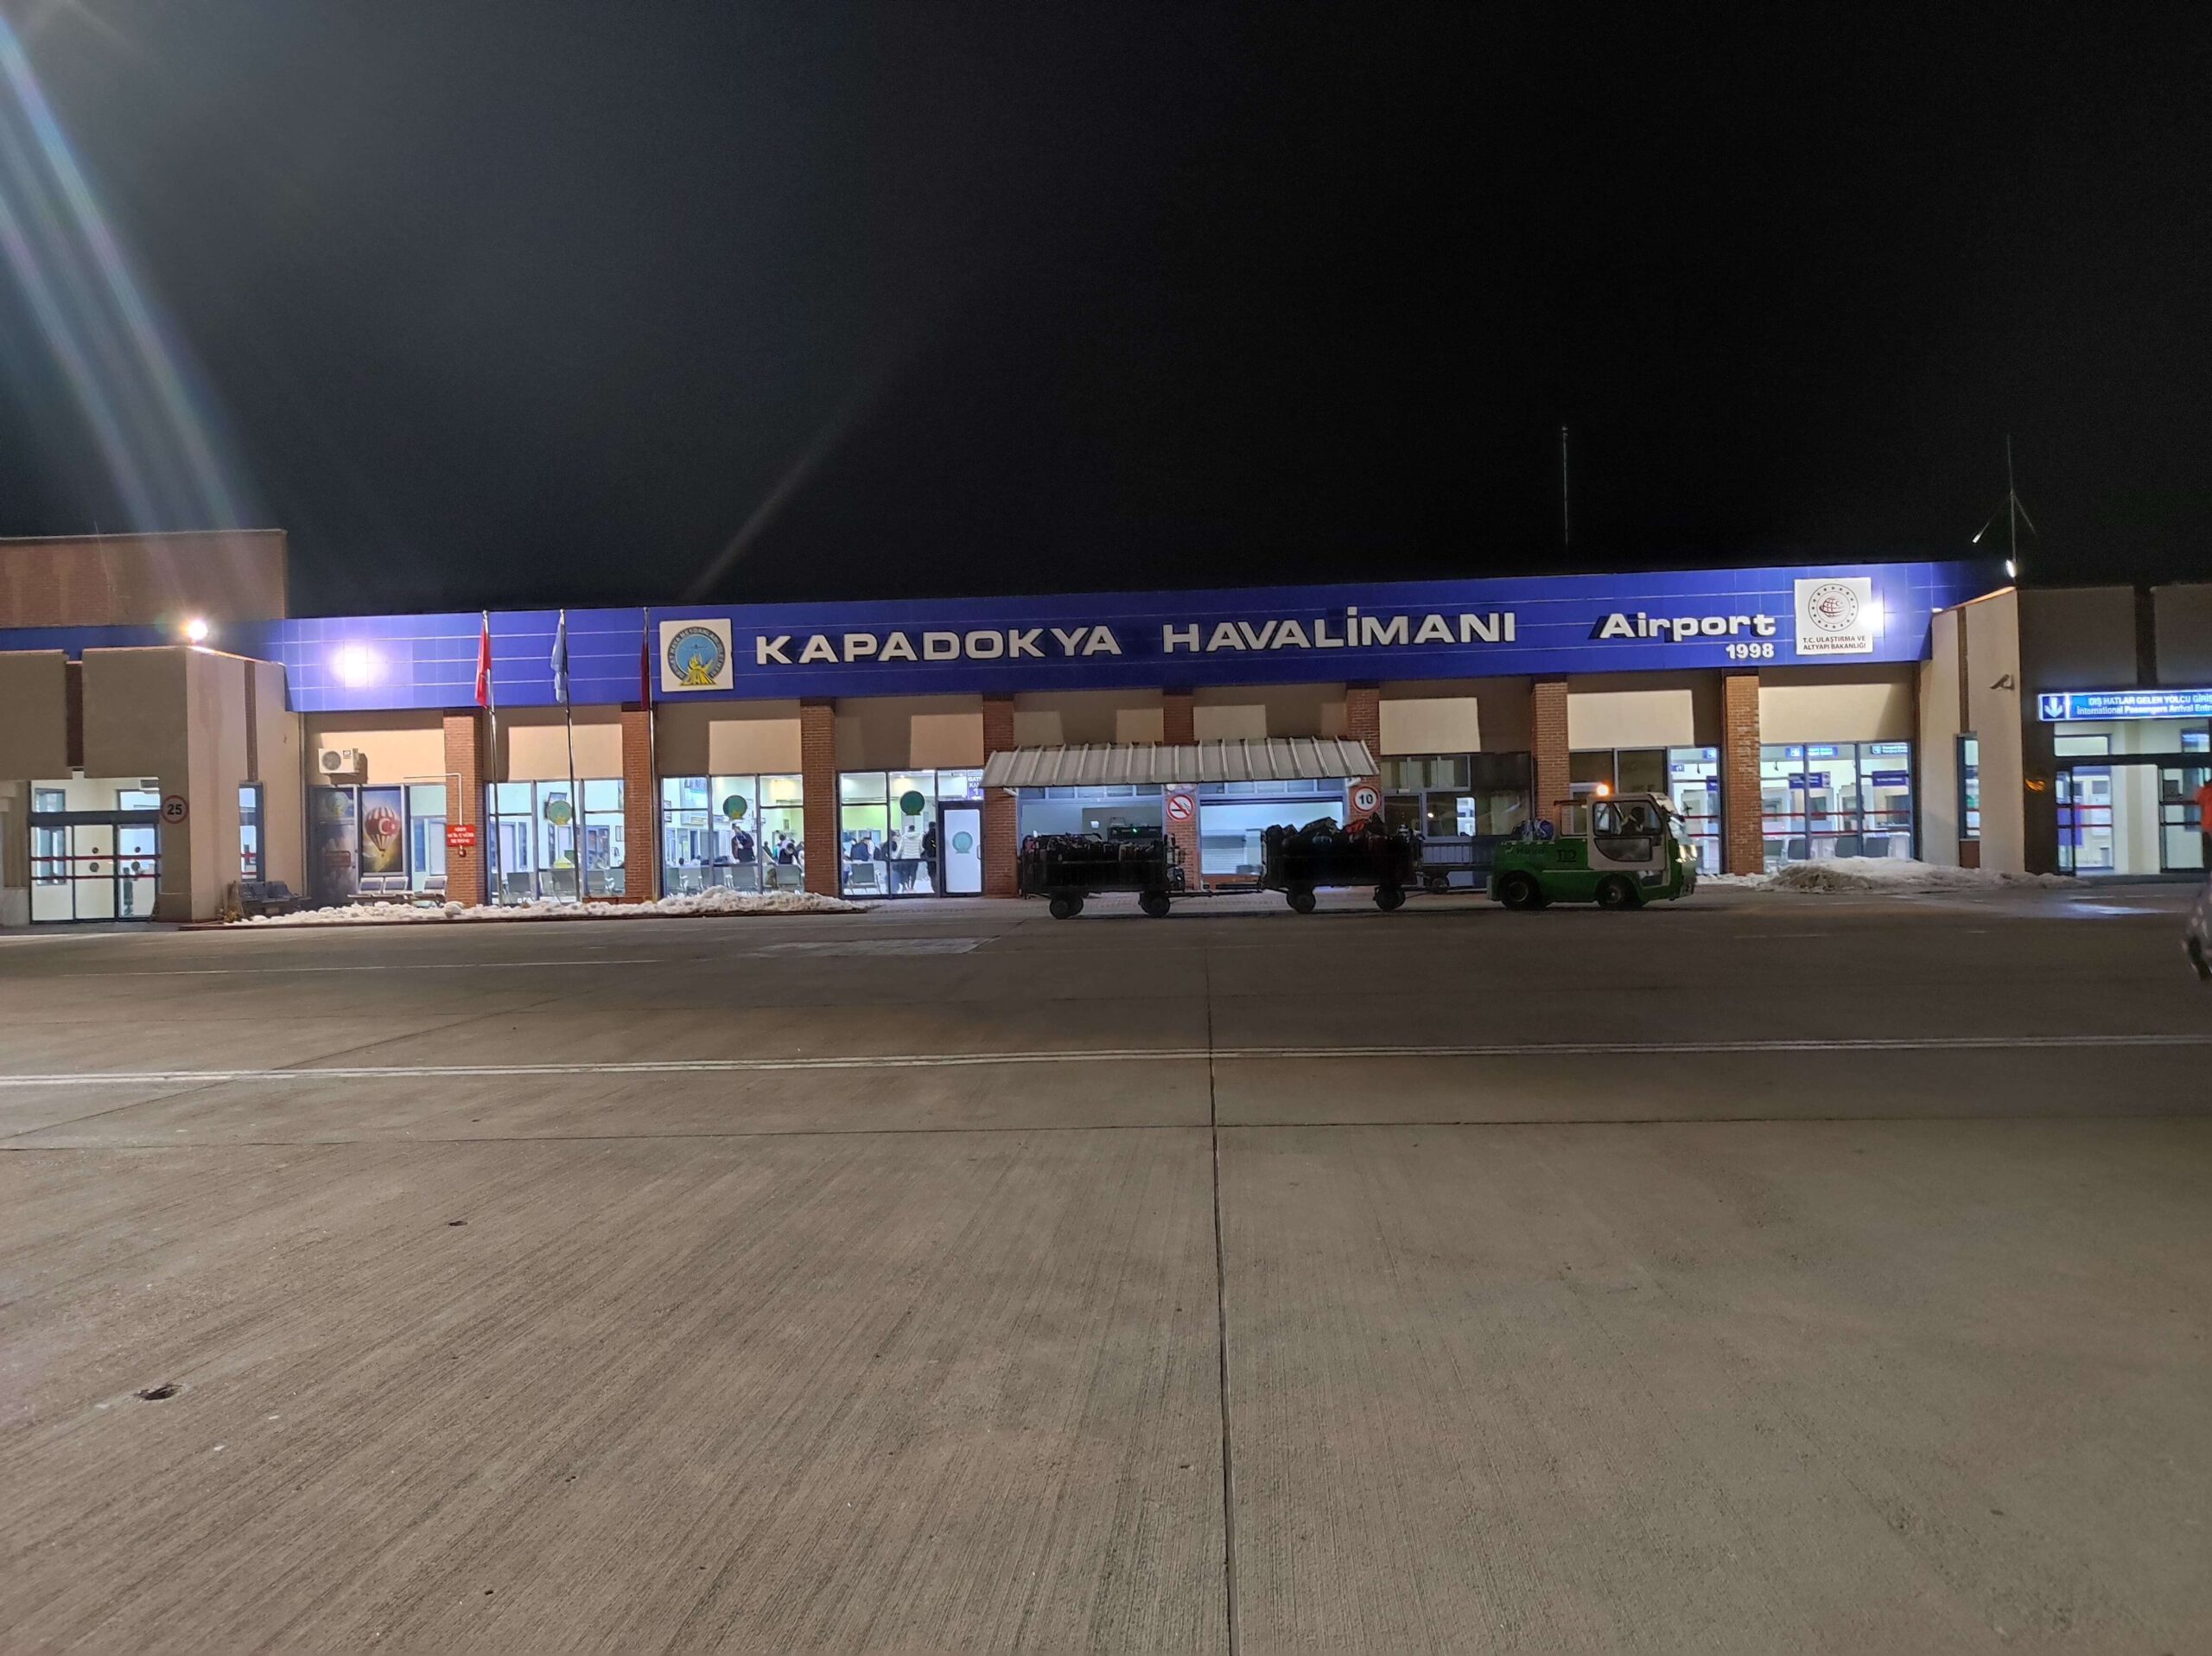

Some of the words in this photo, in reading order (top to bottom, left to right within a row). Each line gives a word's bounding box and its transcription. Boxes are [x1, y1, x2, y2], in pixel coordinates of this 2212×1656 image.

[1599, 612, 1777, 642] Airport
[756, 625, 1122, 665] KAPADOKYA
[1162, 606, 1516, 653] HAVALİMANI
[1726, 642, 1775, 659] 1998
[2103, 696, 2135, 705] HATLAR
[2136, 696, 2164, 704] GELEN
[2164, 695, 2190, 704] YOLCU
[1359, 793, 1373, 805] 10
[167, 804, 182, 815] 25
